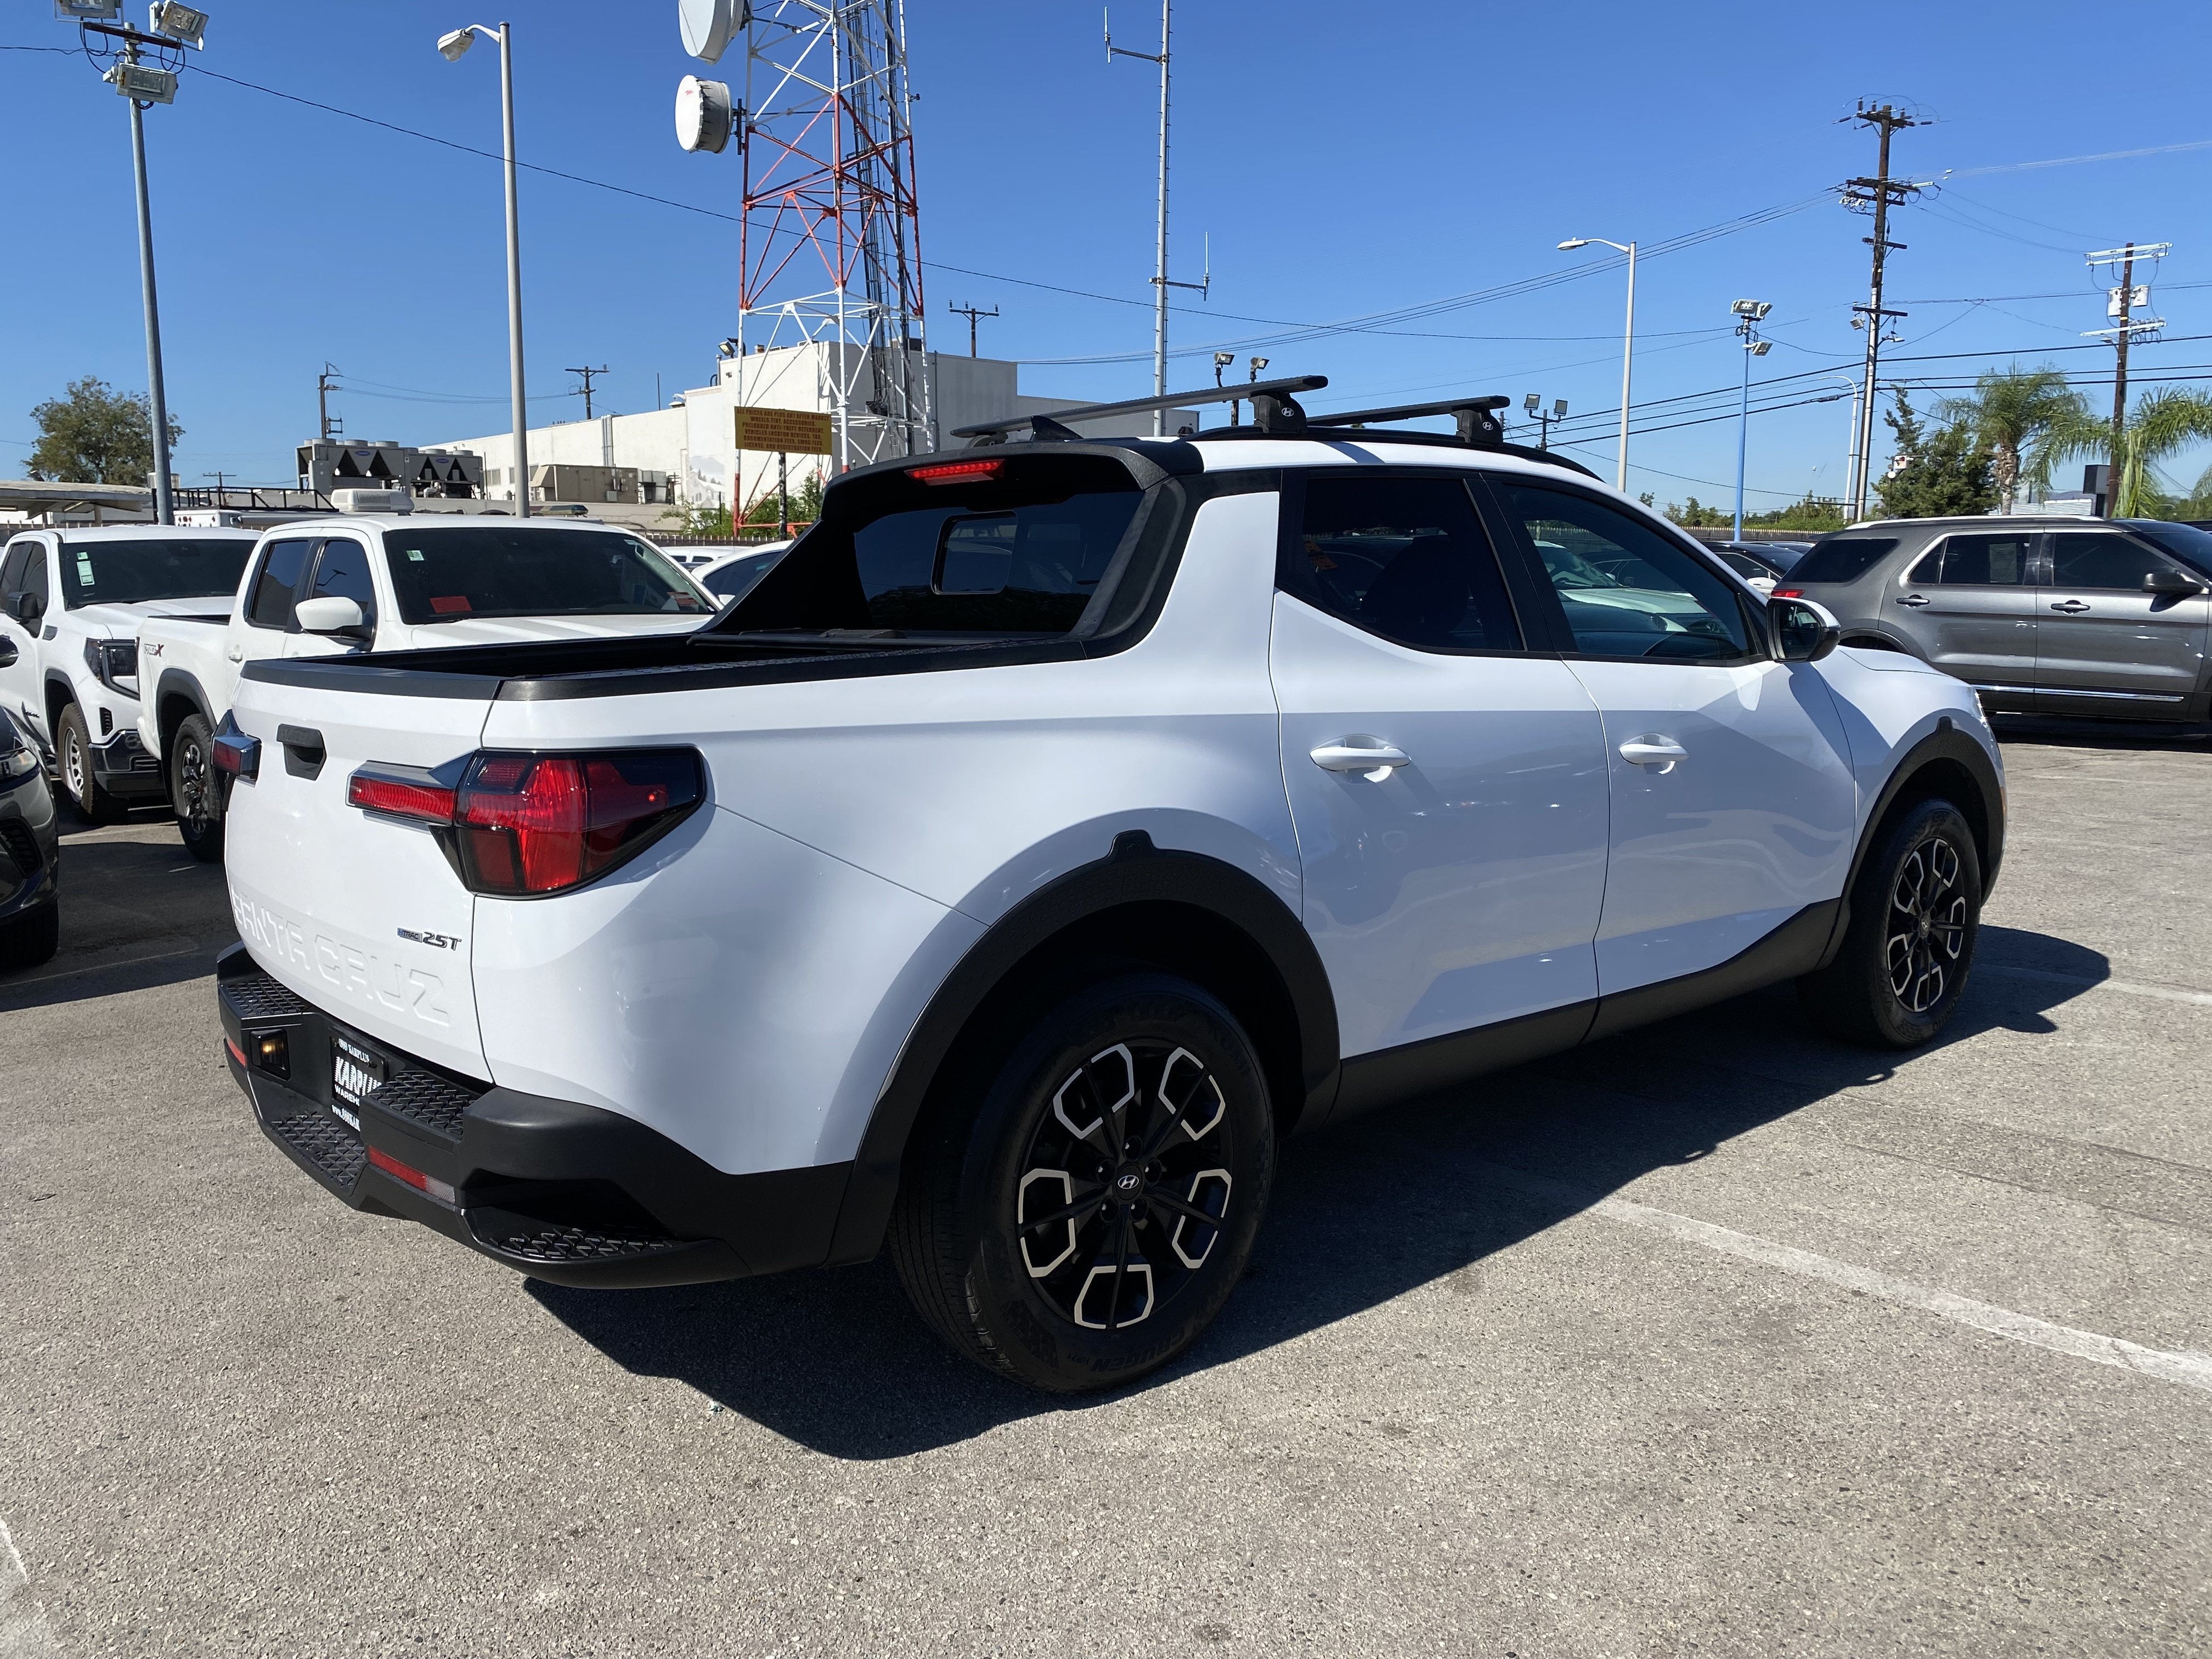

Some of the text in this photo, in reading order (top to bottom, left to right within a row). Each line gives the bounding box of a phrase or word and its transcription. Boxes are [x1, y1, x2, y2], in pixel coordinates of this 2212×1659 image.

[398, 928, 420, 941] HTRAC
[230, 883, 450, 1027] SANTA CRUZ
[348, 1043, 370, 1063] KARPLUS
